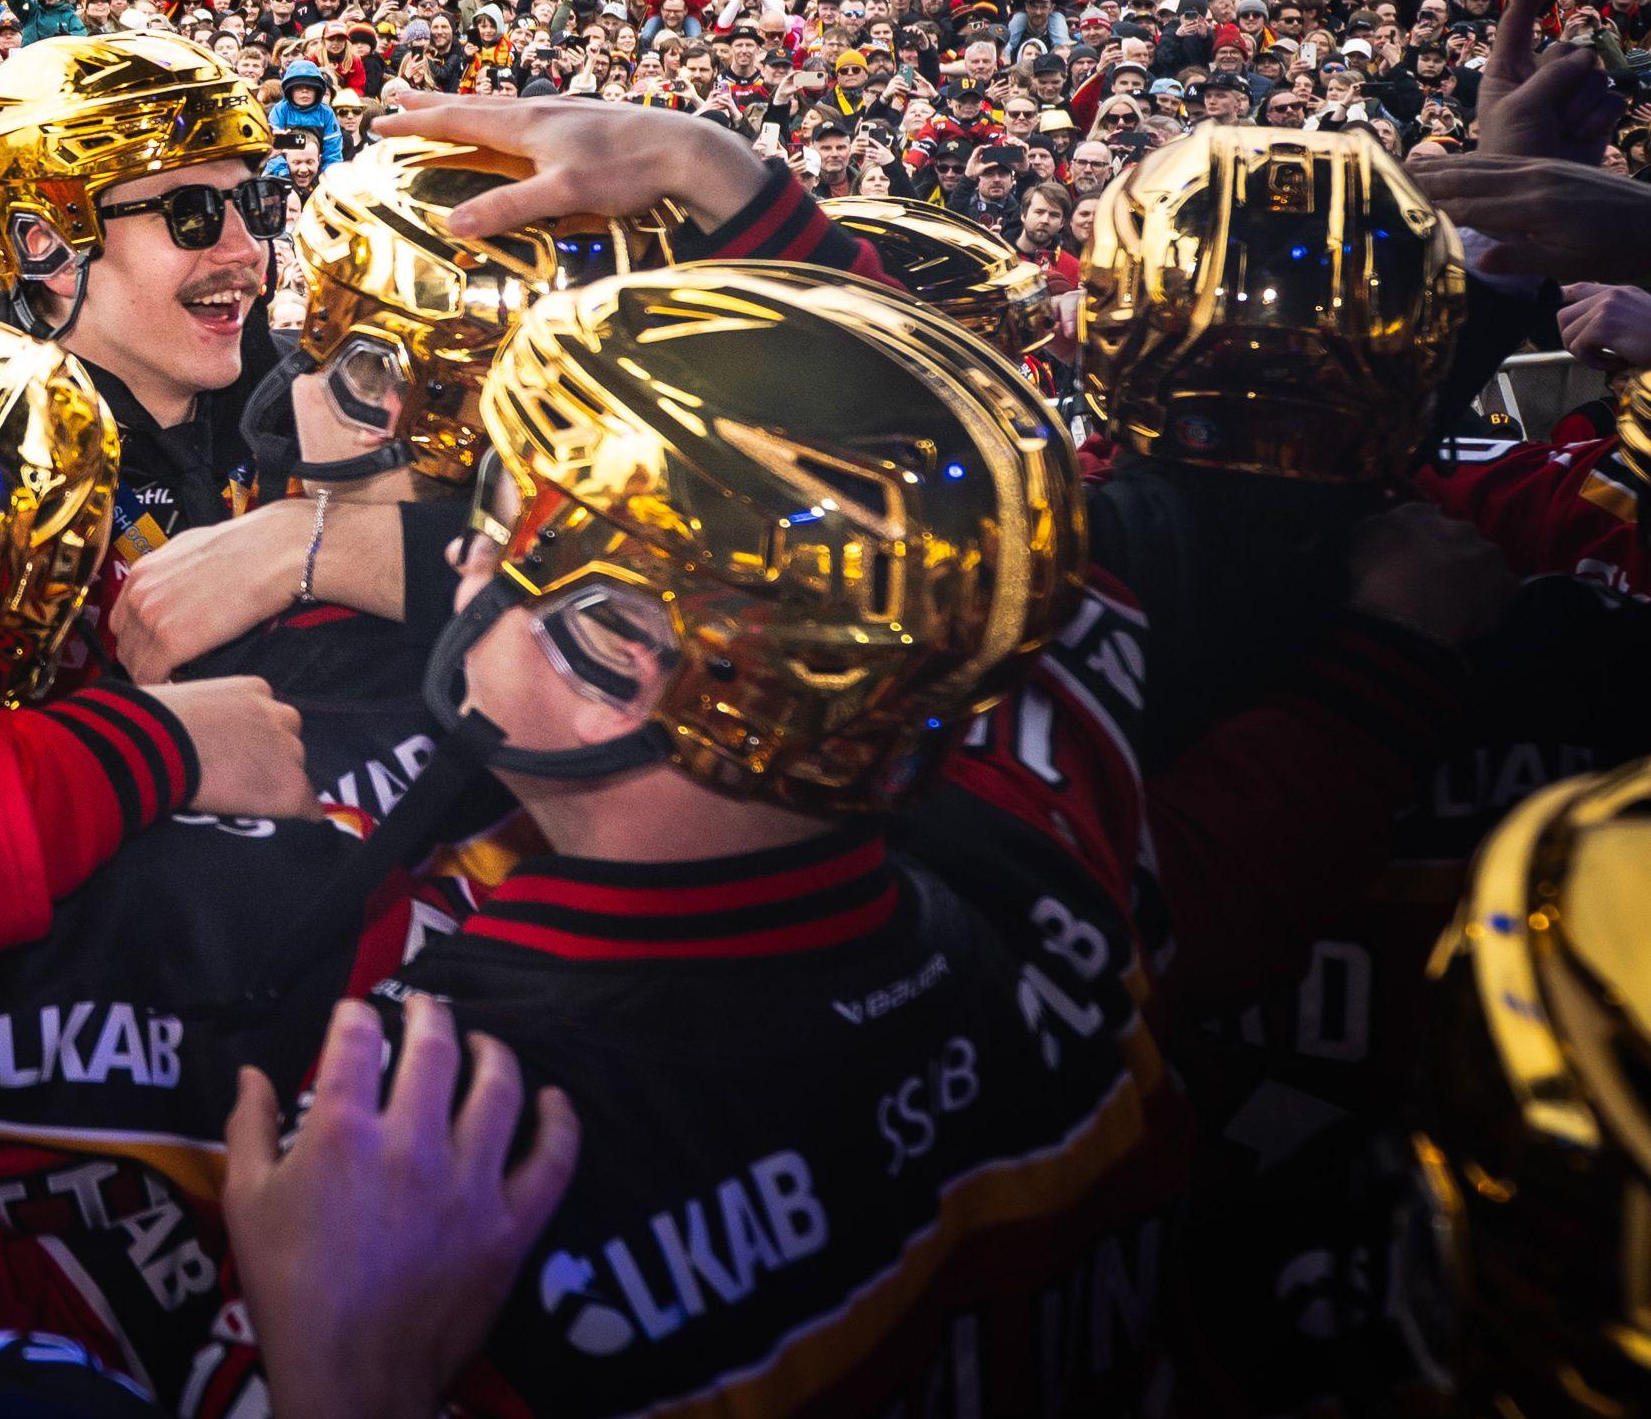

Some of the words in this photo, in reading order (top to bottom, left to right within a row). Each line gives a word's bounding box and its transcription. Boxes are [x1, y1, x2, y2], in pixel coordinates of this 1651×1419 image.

[961, 78, 977, 89] 67
[1490, 413, 1509, 424] 67
[603, 1149, 830, 1342] LKAB
